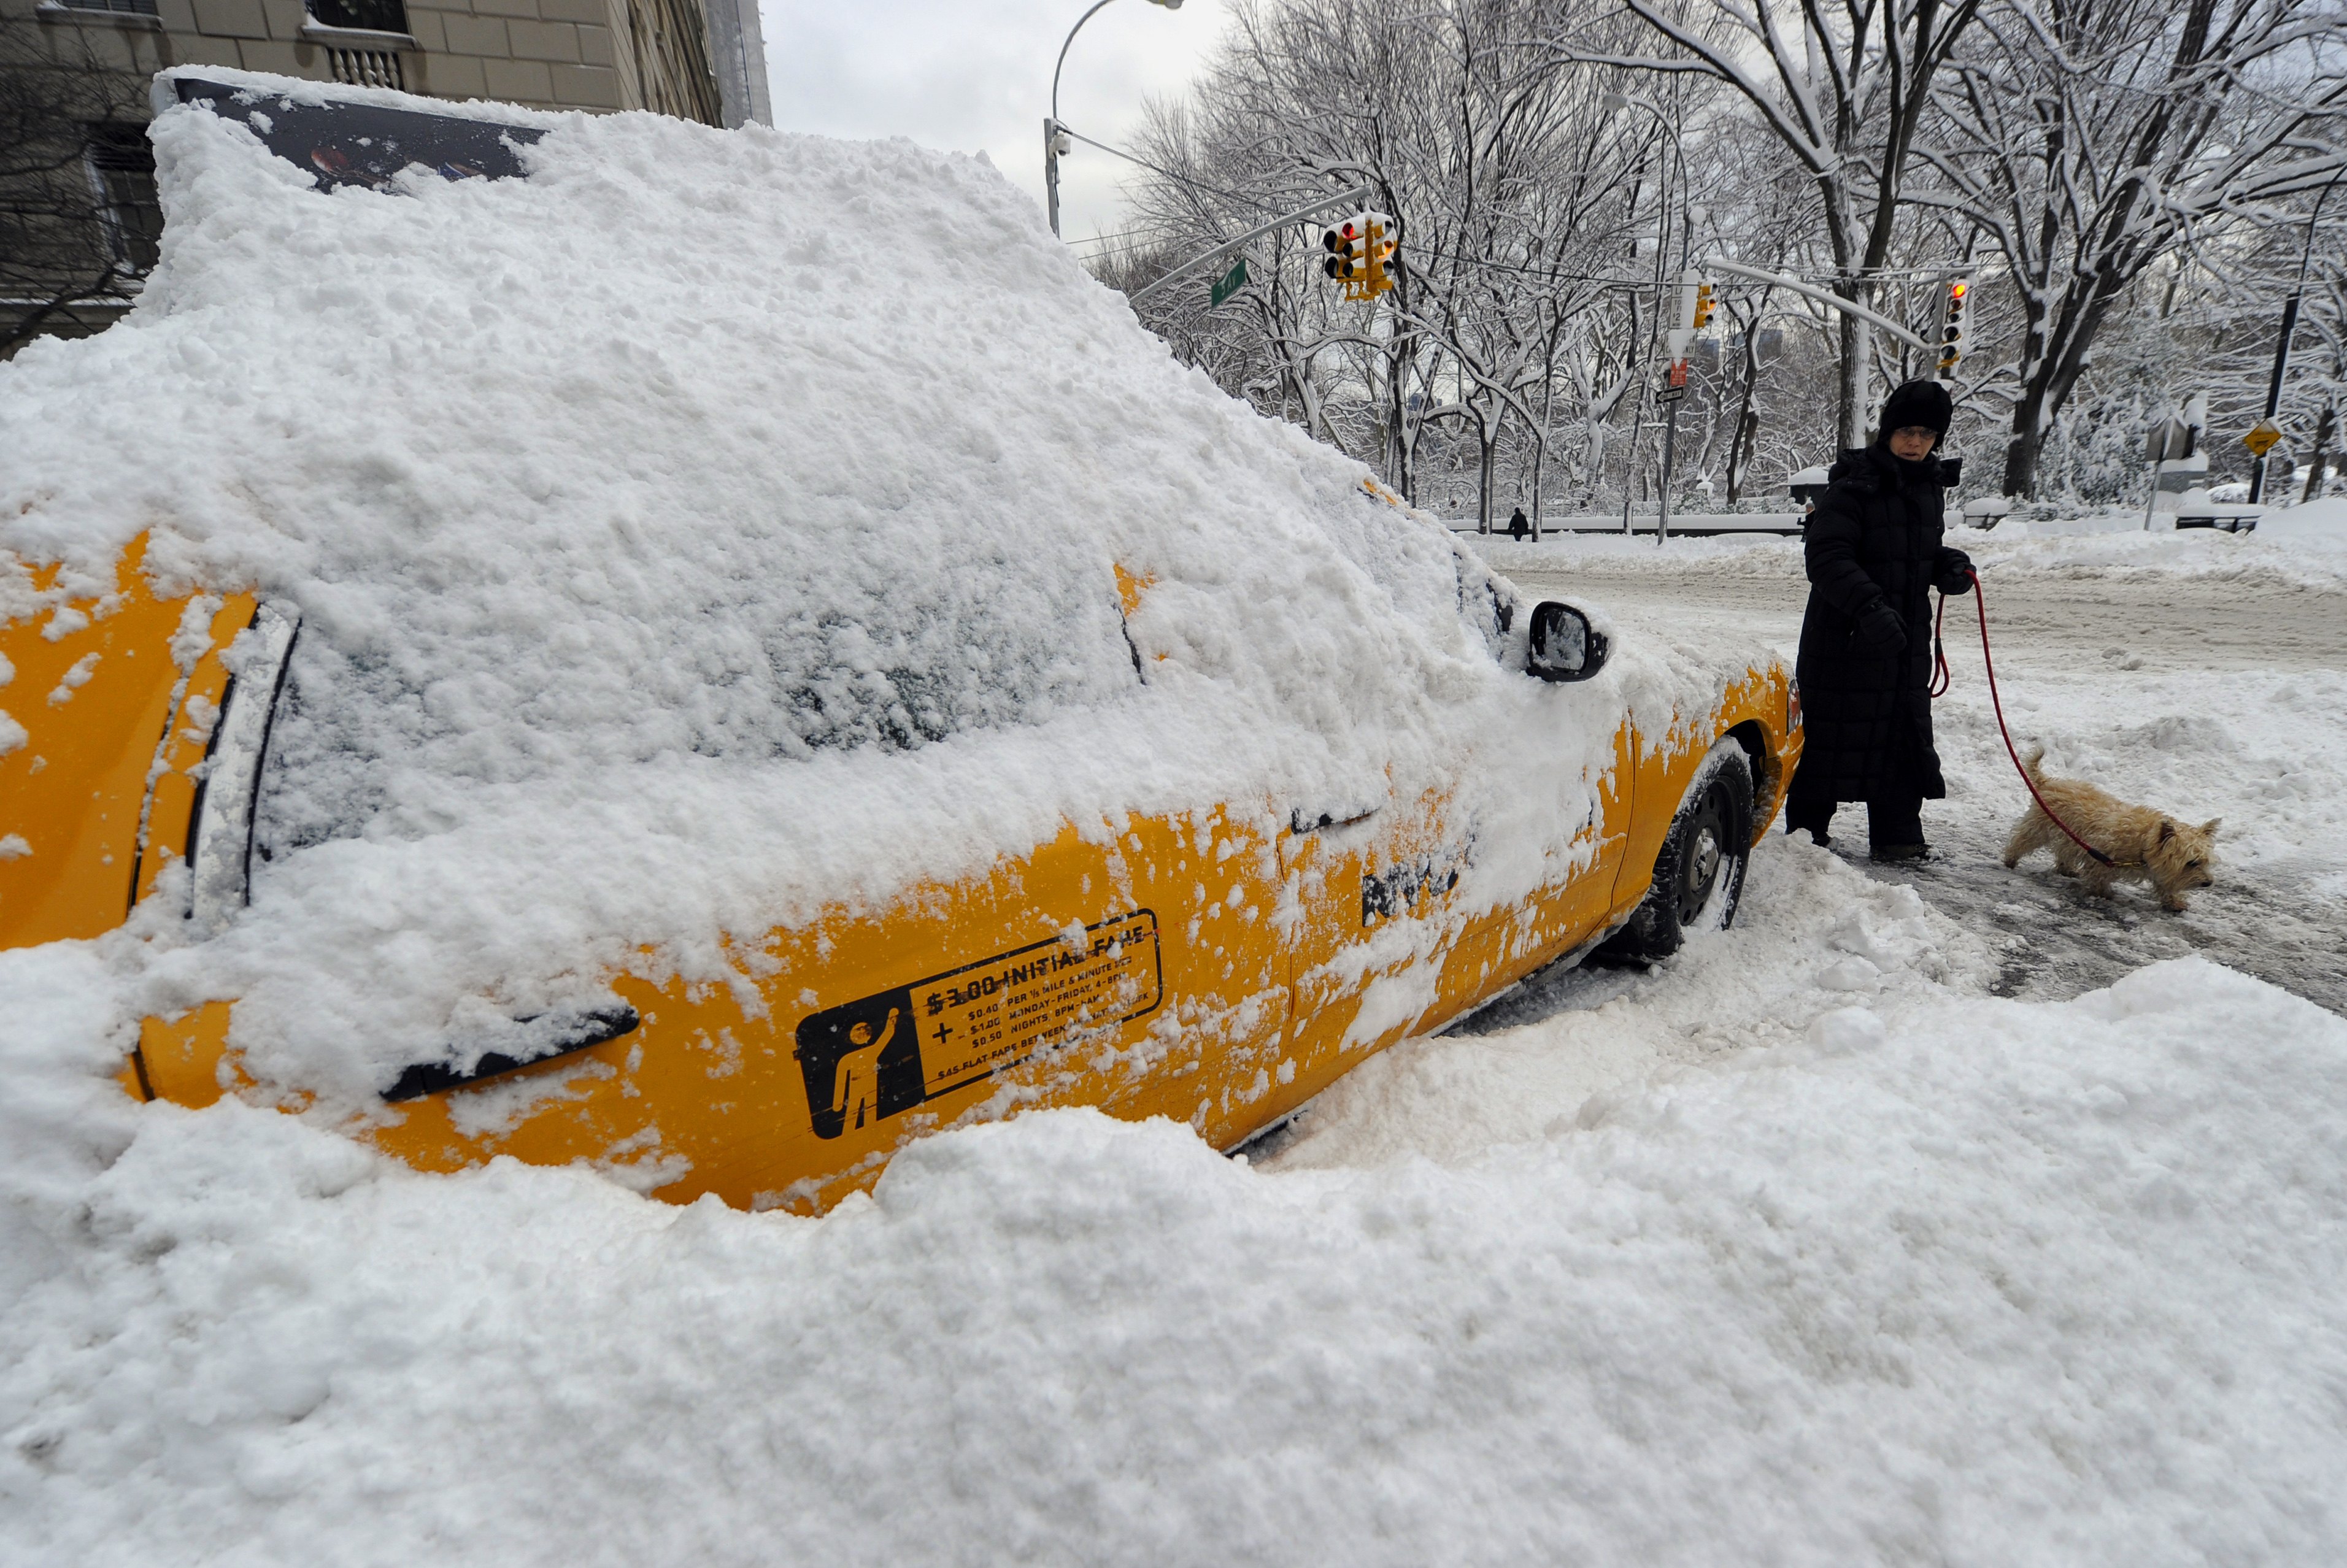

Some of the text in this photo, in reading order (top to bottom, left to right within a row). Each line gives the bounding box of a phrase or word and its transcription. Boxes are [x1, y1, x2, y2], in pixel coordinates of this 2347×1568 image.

[968, 1003, 998, 1021] $0.40
[1007, 993, 1027, 1007] PER
[1042, 979, 1065, 994] MILE
[1068, 976, 1075, 985] &
[1077, 963, 1112, 982] MINUTE
[971, 1017, 1000, 1035] $1.00
[972, 1031, 1002, 1048] $0.50
[962, 1054, 988, 1070] FLAT
